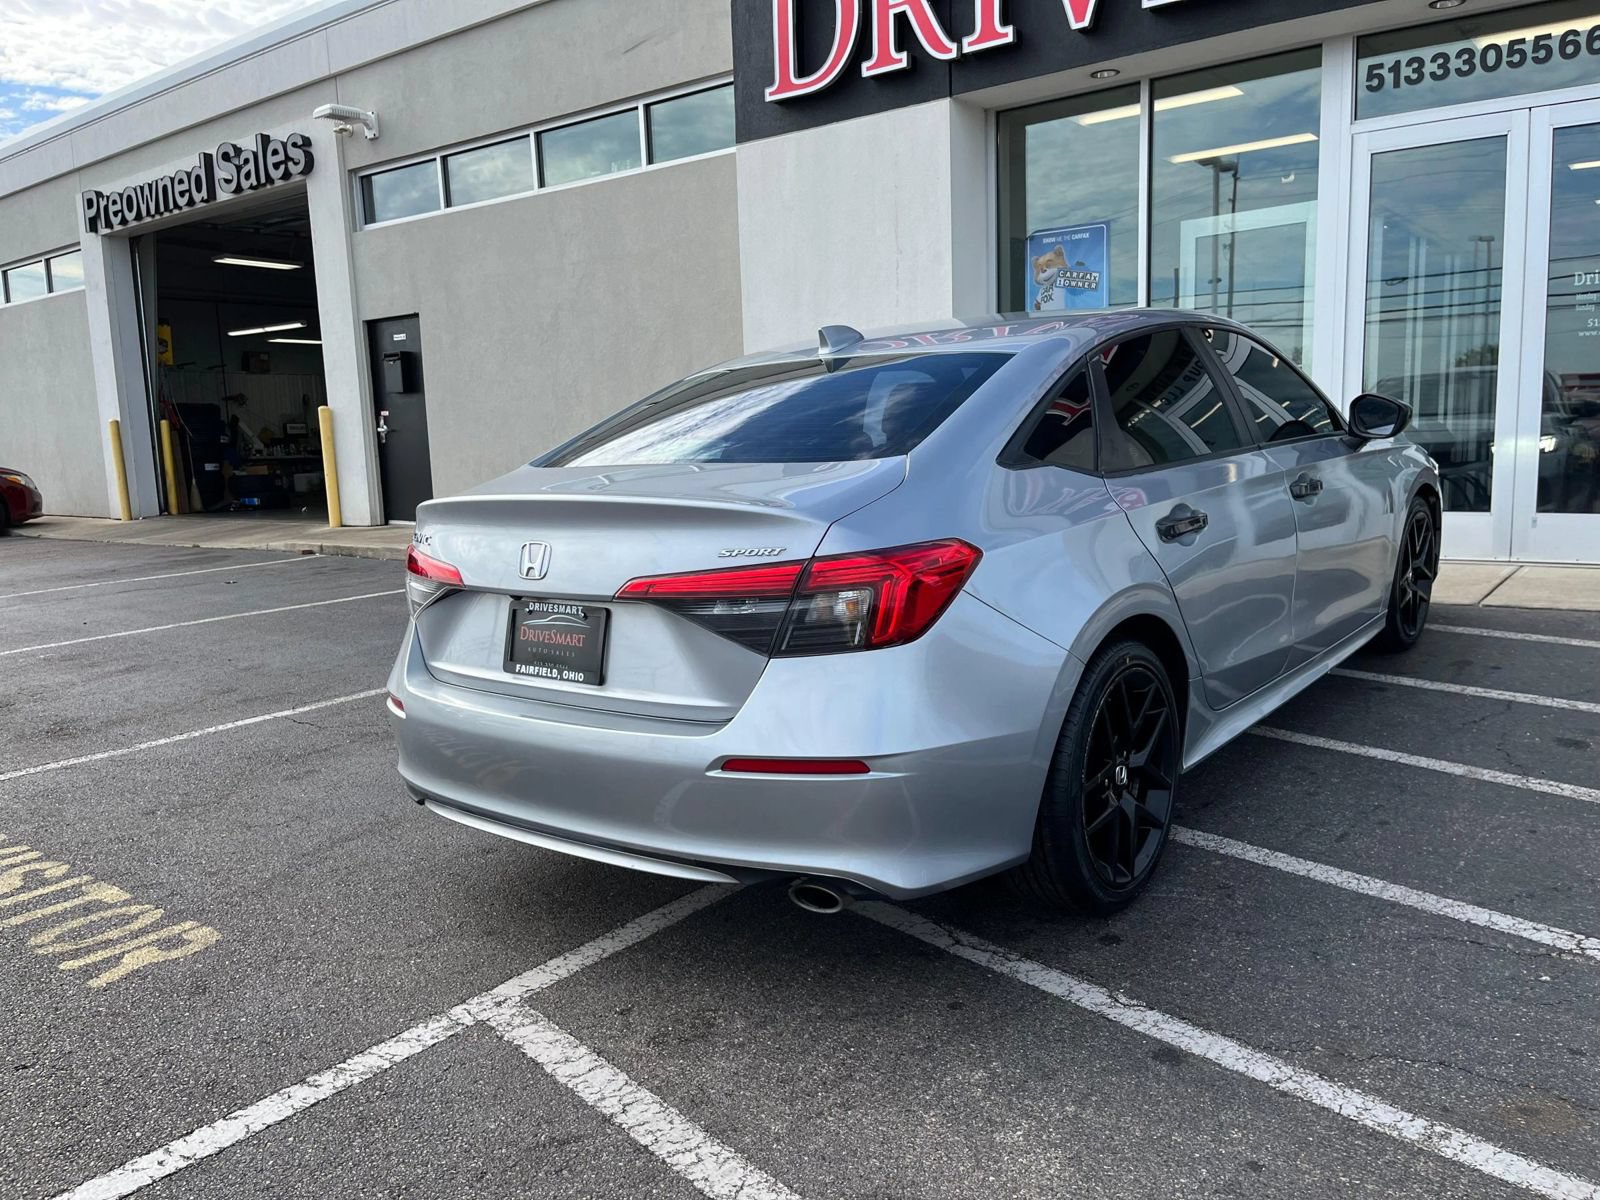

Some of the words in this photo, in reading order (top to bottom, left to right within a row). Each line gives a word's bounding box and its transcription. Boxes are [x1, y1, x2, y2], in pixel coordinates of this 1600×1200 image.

[82, 152, 217, 233] Preowned
[215, 132, 315, 194] Sales
[1059, 270, 1099, 282] CARFAX
[718, 547, 787, 558] SPORT
[529, 602, 583, 614] DRIVESMART
[515, 664, 560, 681] FAIRFIELD,
[562, 670, 585, 682] OHIO
